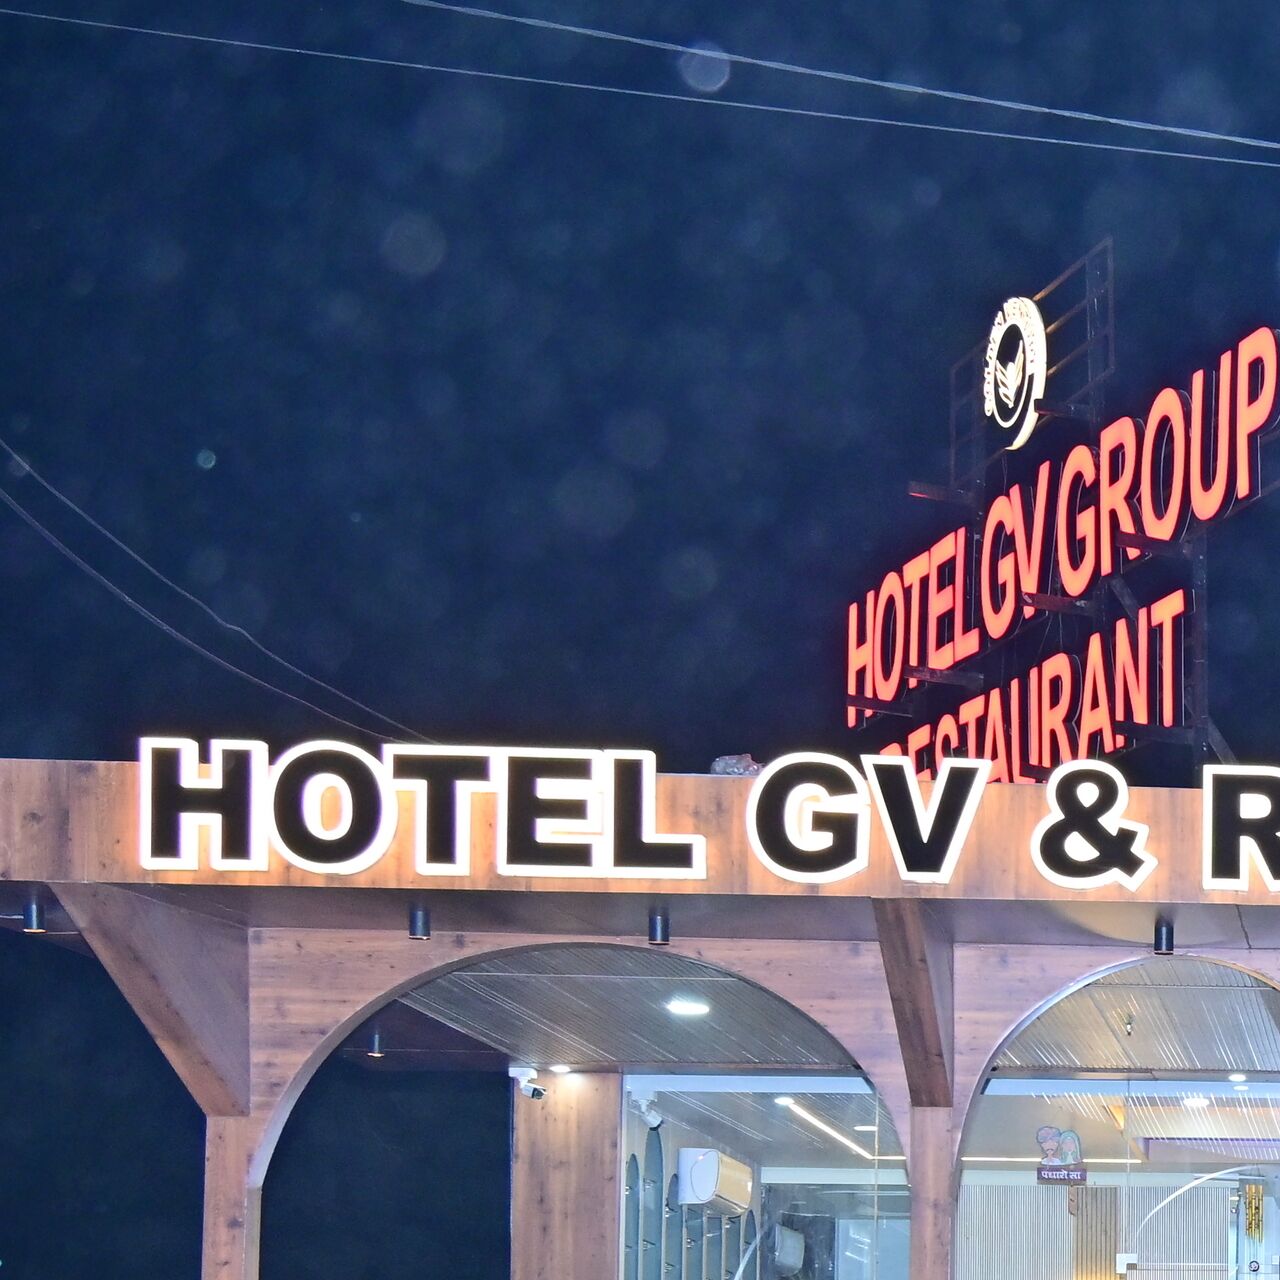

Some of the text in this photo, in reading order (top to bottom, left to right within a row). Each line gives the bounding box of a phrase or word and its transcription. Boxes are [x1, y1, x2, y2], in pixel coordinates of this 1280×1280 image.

[847, 526, 980, 728] HOTEL
[980, 460, 1053, 639] GV
[140, 737, 708, 882] HOTEL
[745, 752, 990, 885] GV
[1030, 760, 1158, 892] &
